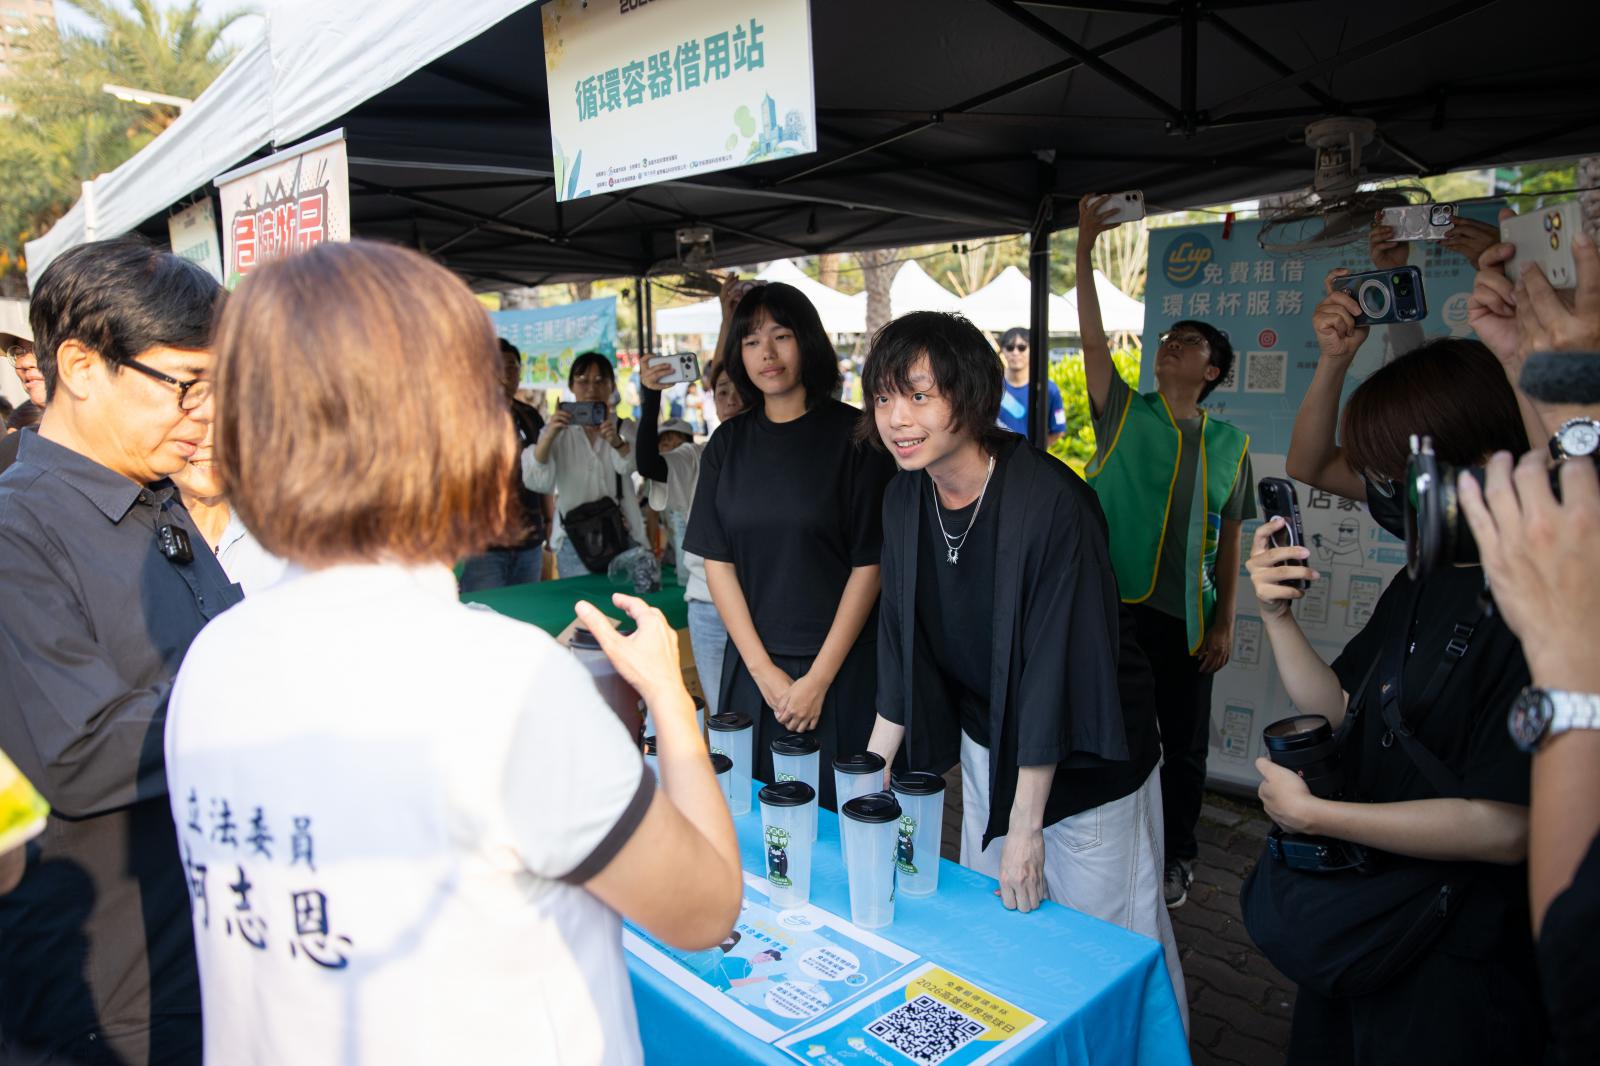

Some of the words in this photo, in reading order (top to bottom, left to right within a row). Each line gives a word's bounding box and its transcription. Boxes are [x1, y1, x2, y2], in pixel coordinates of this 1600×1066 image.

[574, 18, 765, 122] 循環容器借用站
[1201, 259, 1305, 285] 免費租借
[1162, 289, 1304, 318] 環保杯服務
[916, 978, 1016, 1033] 2026高雄世界地球日
